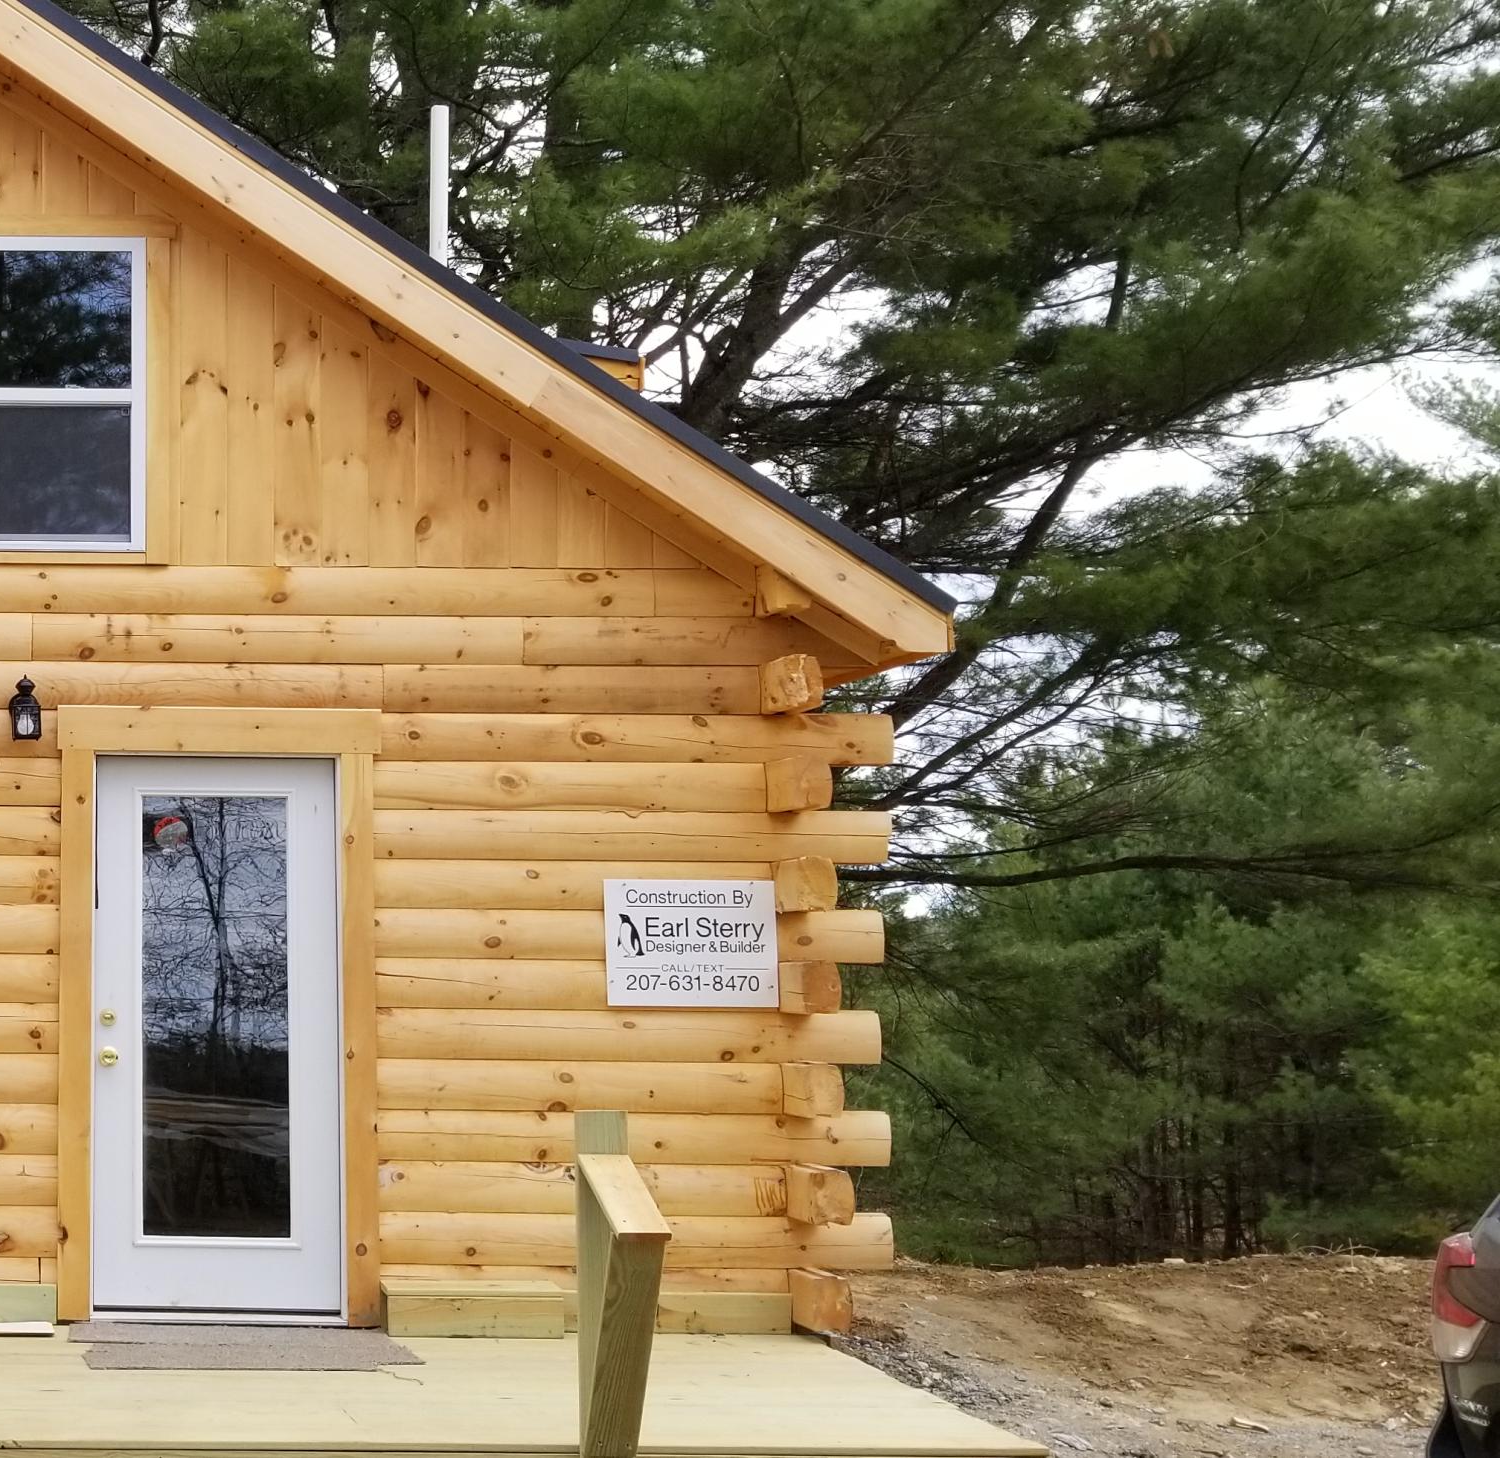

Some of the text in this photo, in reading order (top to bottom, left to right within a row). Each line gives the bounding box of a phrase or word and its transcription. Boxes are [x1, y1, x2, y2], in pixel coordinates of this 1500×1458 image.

[626, 889, 754, 908] Construction By
[645, 917, 765, 943] Earl Sterry
[645, 940, 766, 955] Designer & Builder
[661, 963, 725, 973] CALL/TEXT
[626, 974, 760, 992] 207-631-8470
